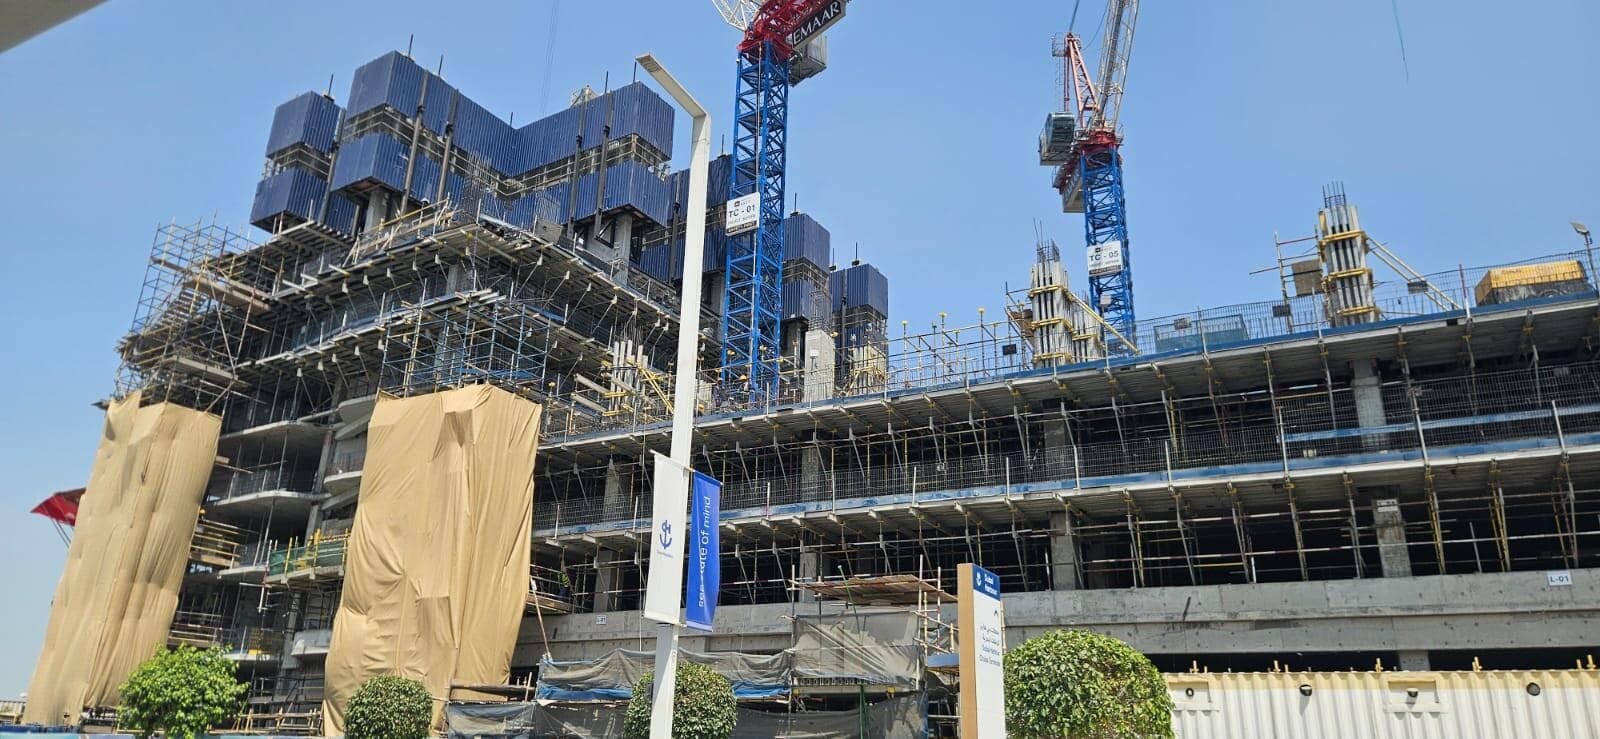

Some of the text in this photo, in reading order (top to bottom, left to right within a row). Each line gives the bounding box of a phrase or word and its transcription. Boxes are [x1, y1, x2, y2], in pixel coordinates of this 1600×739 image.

[793, 2, 839, 44] EMAAR
[728, 209, 739, 217] TC
[746, 204, 755, 213] 01
[1109, 250, 1119, 258] 05
[703, 496, 711, 529] mind
[702, 530, 709, 546] of
[1550, 575, 1568, 583] L-01
